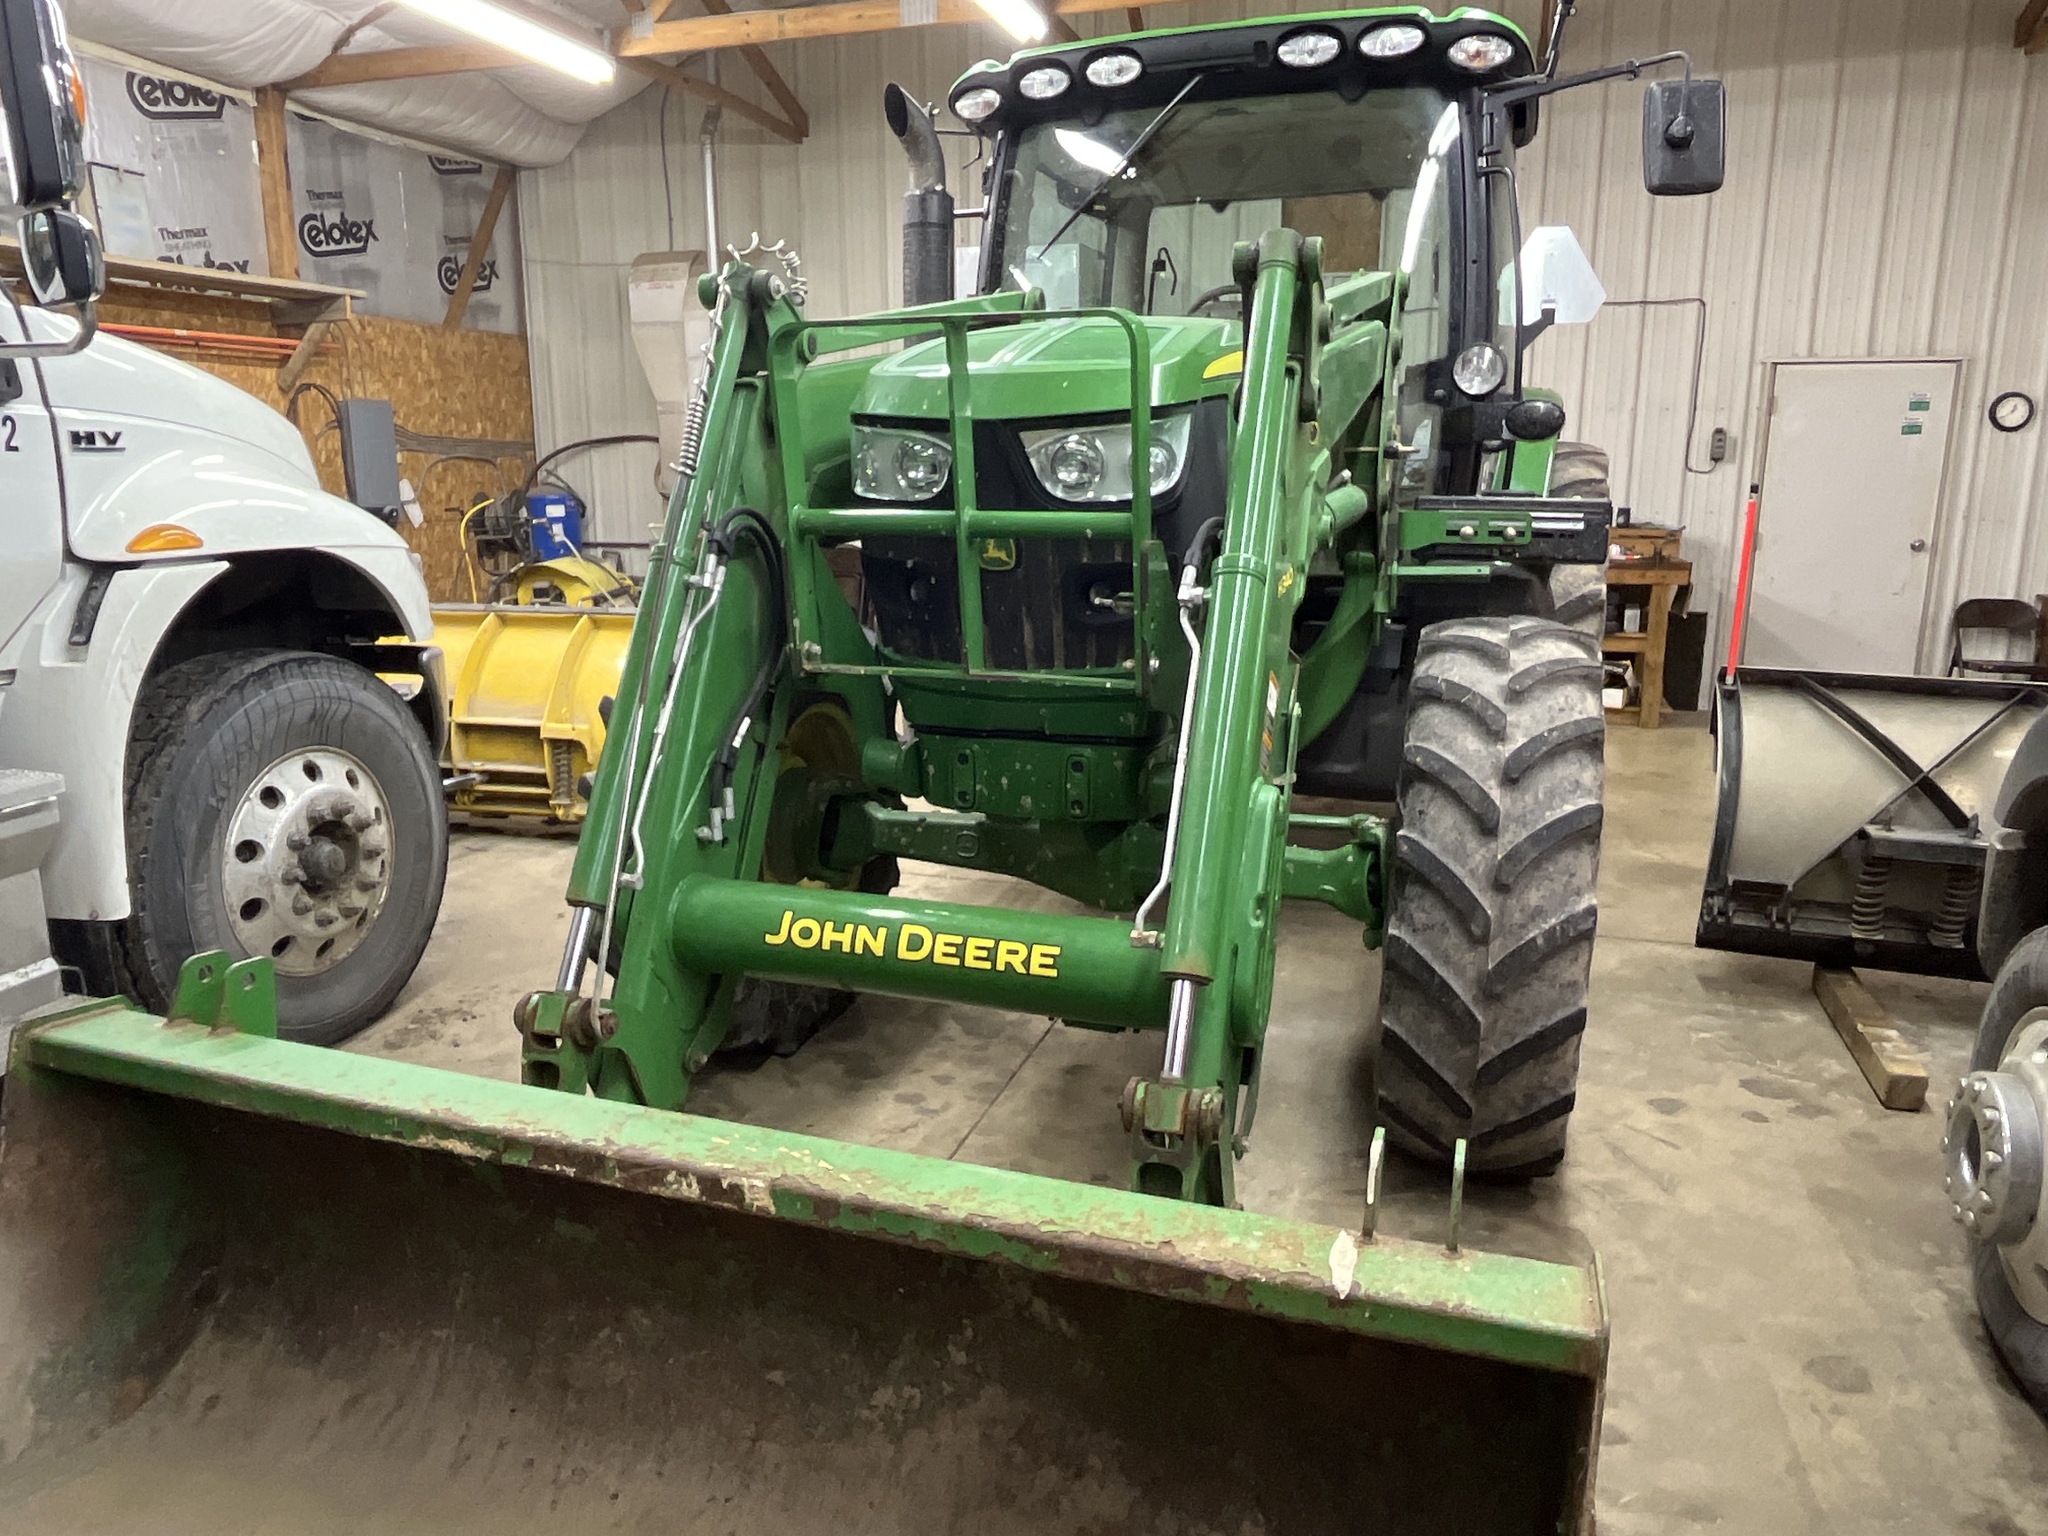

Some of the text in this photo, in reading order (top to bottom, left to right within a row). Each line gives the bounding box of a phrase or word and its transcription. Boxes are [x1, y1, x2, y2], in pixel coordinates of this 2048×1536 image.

[158, 227, 208, 243] Thermax
[299, 211, 379, 257] Celotex
[2, 414, 19, 451] 2
[70, 430, 122, 446] HV
[765, 911, 1061, 978] JOHN DEERE
